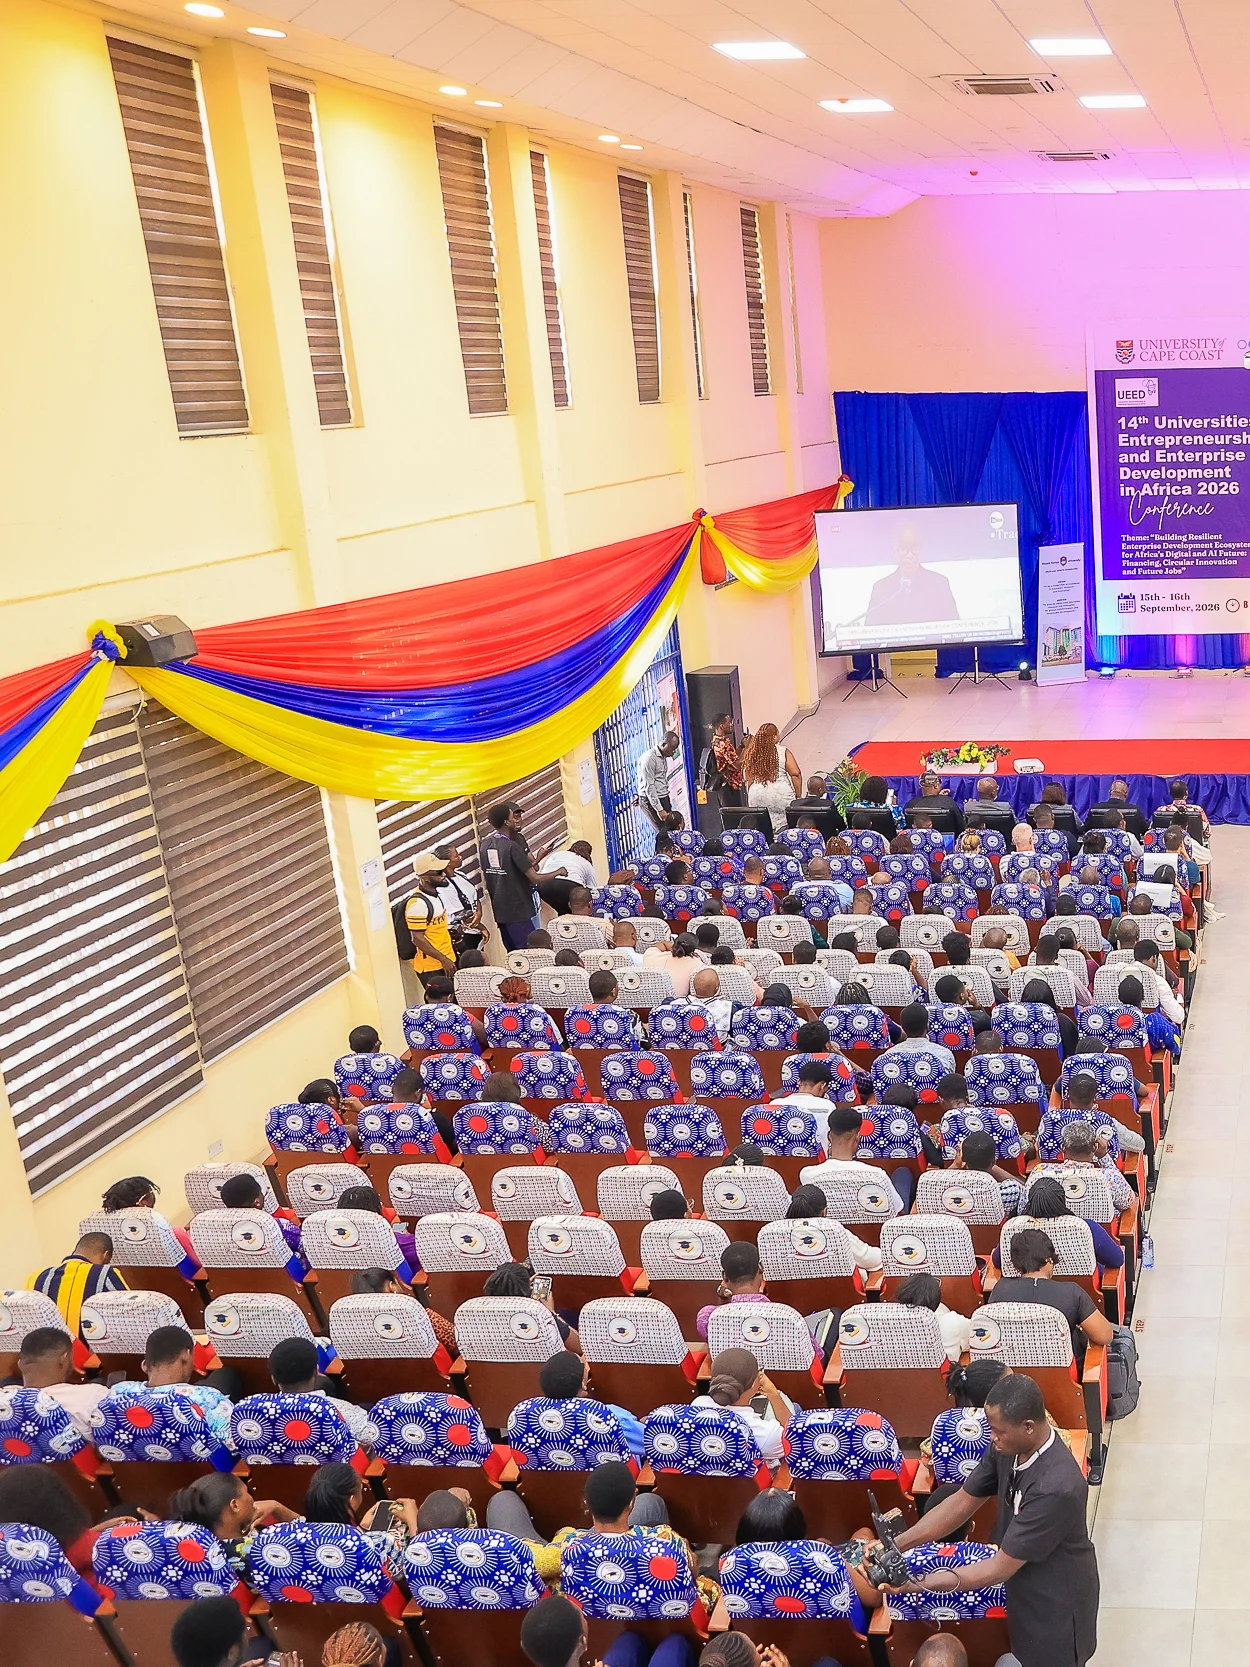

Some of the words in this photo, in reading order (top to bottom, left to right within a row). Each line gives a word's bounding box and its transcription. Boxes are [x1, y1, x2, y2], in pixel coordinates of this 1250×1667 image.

[1139, 338, 1215, 350] UNIVERSITY
[1214, 338, 1227, 349] of
[1140, 351, 1175, 361] CAPE
[1179, 350, 1224, 361] COAST
[1118, 390, 1145, 399] UEED
[1118, 416, 1149, 430] 14th
[1118, 450, 1150, 463] and
[1155, 449, 1246, 464] Enterprise
[1119, 465, 1232, 481] Development
[1120, 484, 1135, 496] in
[1140, 483, 1192, 496] Africa
[1197, 482, 1240, 495] 2026
[1129, 490, 1214, 530] Conference
[1163, 542, 1213, 550] Development
[1165, 551, 1191, 559] Digital
[1195, 558, 1238, 566] Innovation
[1140, 593, 1160, 601] 15th
[1140, 604, 1194, 614] September,
[1195, 603, 1220, 612] 2026
[1243, 600, 1249, 609] 8
[1135, 1319, 1144, 1333] STEP
